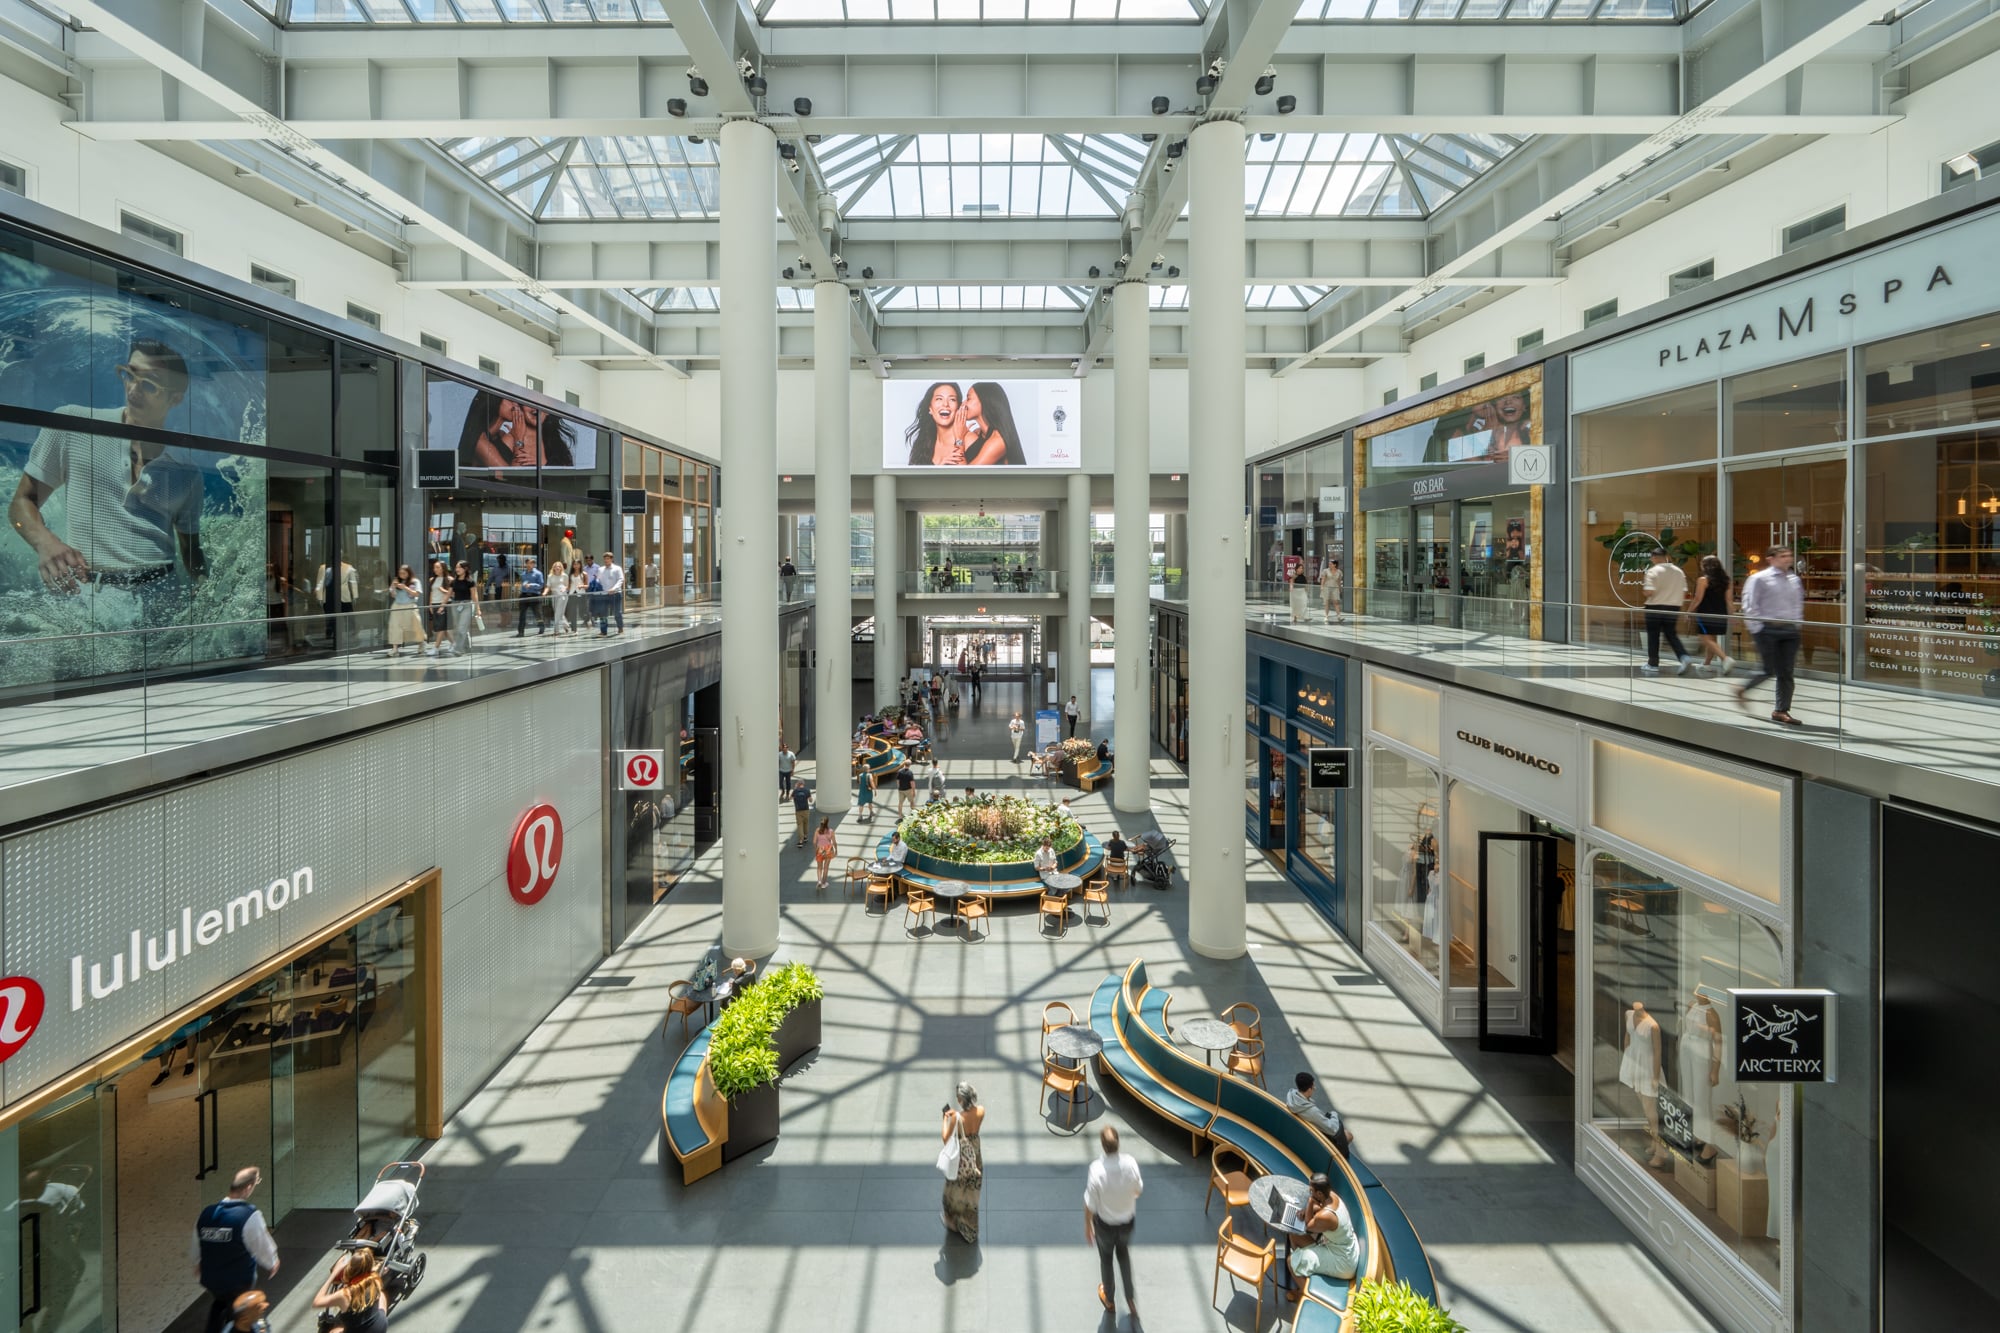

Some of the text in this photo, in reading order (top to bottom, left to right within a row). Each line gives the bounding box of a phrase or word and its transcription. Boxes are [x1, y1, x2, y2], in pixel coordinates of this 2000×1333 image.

[1659, 265, 1952, 367] PLAZA M SPA
[1523, 457, 1538, 472] M
[1413, 477, 1444, 495] COS BAR
[542, 510, 572, 520] SUITSUPPLY
[1623, 552, 1637, 560] your
[1870, 589, 1984, 600] NON-TOXIC MANICURES
[1870, 604, 1912, 612] ORGANIC
[1935, 607, 1992, 616] PEDICURES
[1870, 618, 1897, 626] CHAIR
[1909, 620, 1931, 629] FULL
[1935, 622, 1964, 630] BODY
[1967, 625, 2000, 633] MASSA
[1869, 632, 1999, 650] NATURAL EYELASH EXTENS
[1869, 647, 1892, 655] FACE
[1904, 650, 1930, 658] BODY
[1934, 653, 1975, 664] WAXING
[1869, 661, 1996, 682] CLEAN BEAUTY PRODUCTS
[1456, 730, 1561, 775] CLUB MONACO
[70, 866, 313, 1012] lululemon
[1739, 1058, 1821, 1073] ARC'TERYX
[1659, 1096, 1689, 1128] 30%
[1663, 1114, 1693, 1143] OFF
